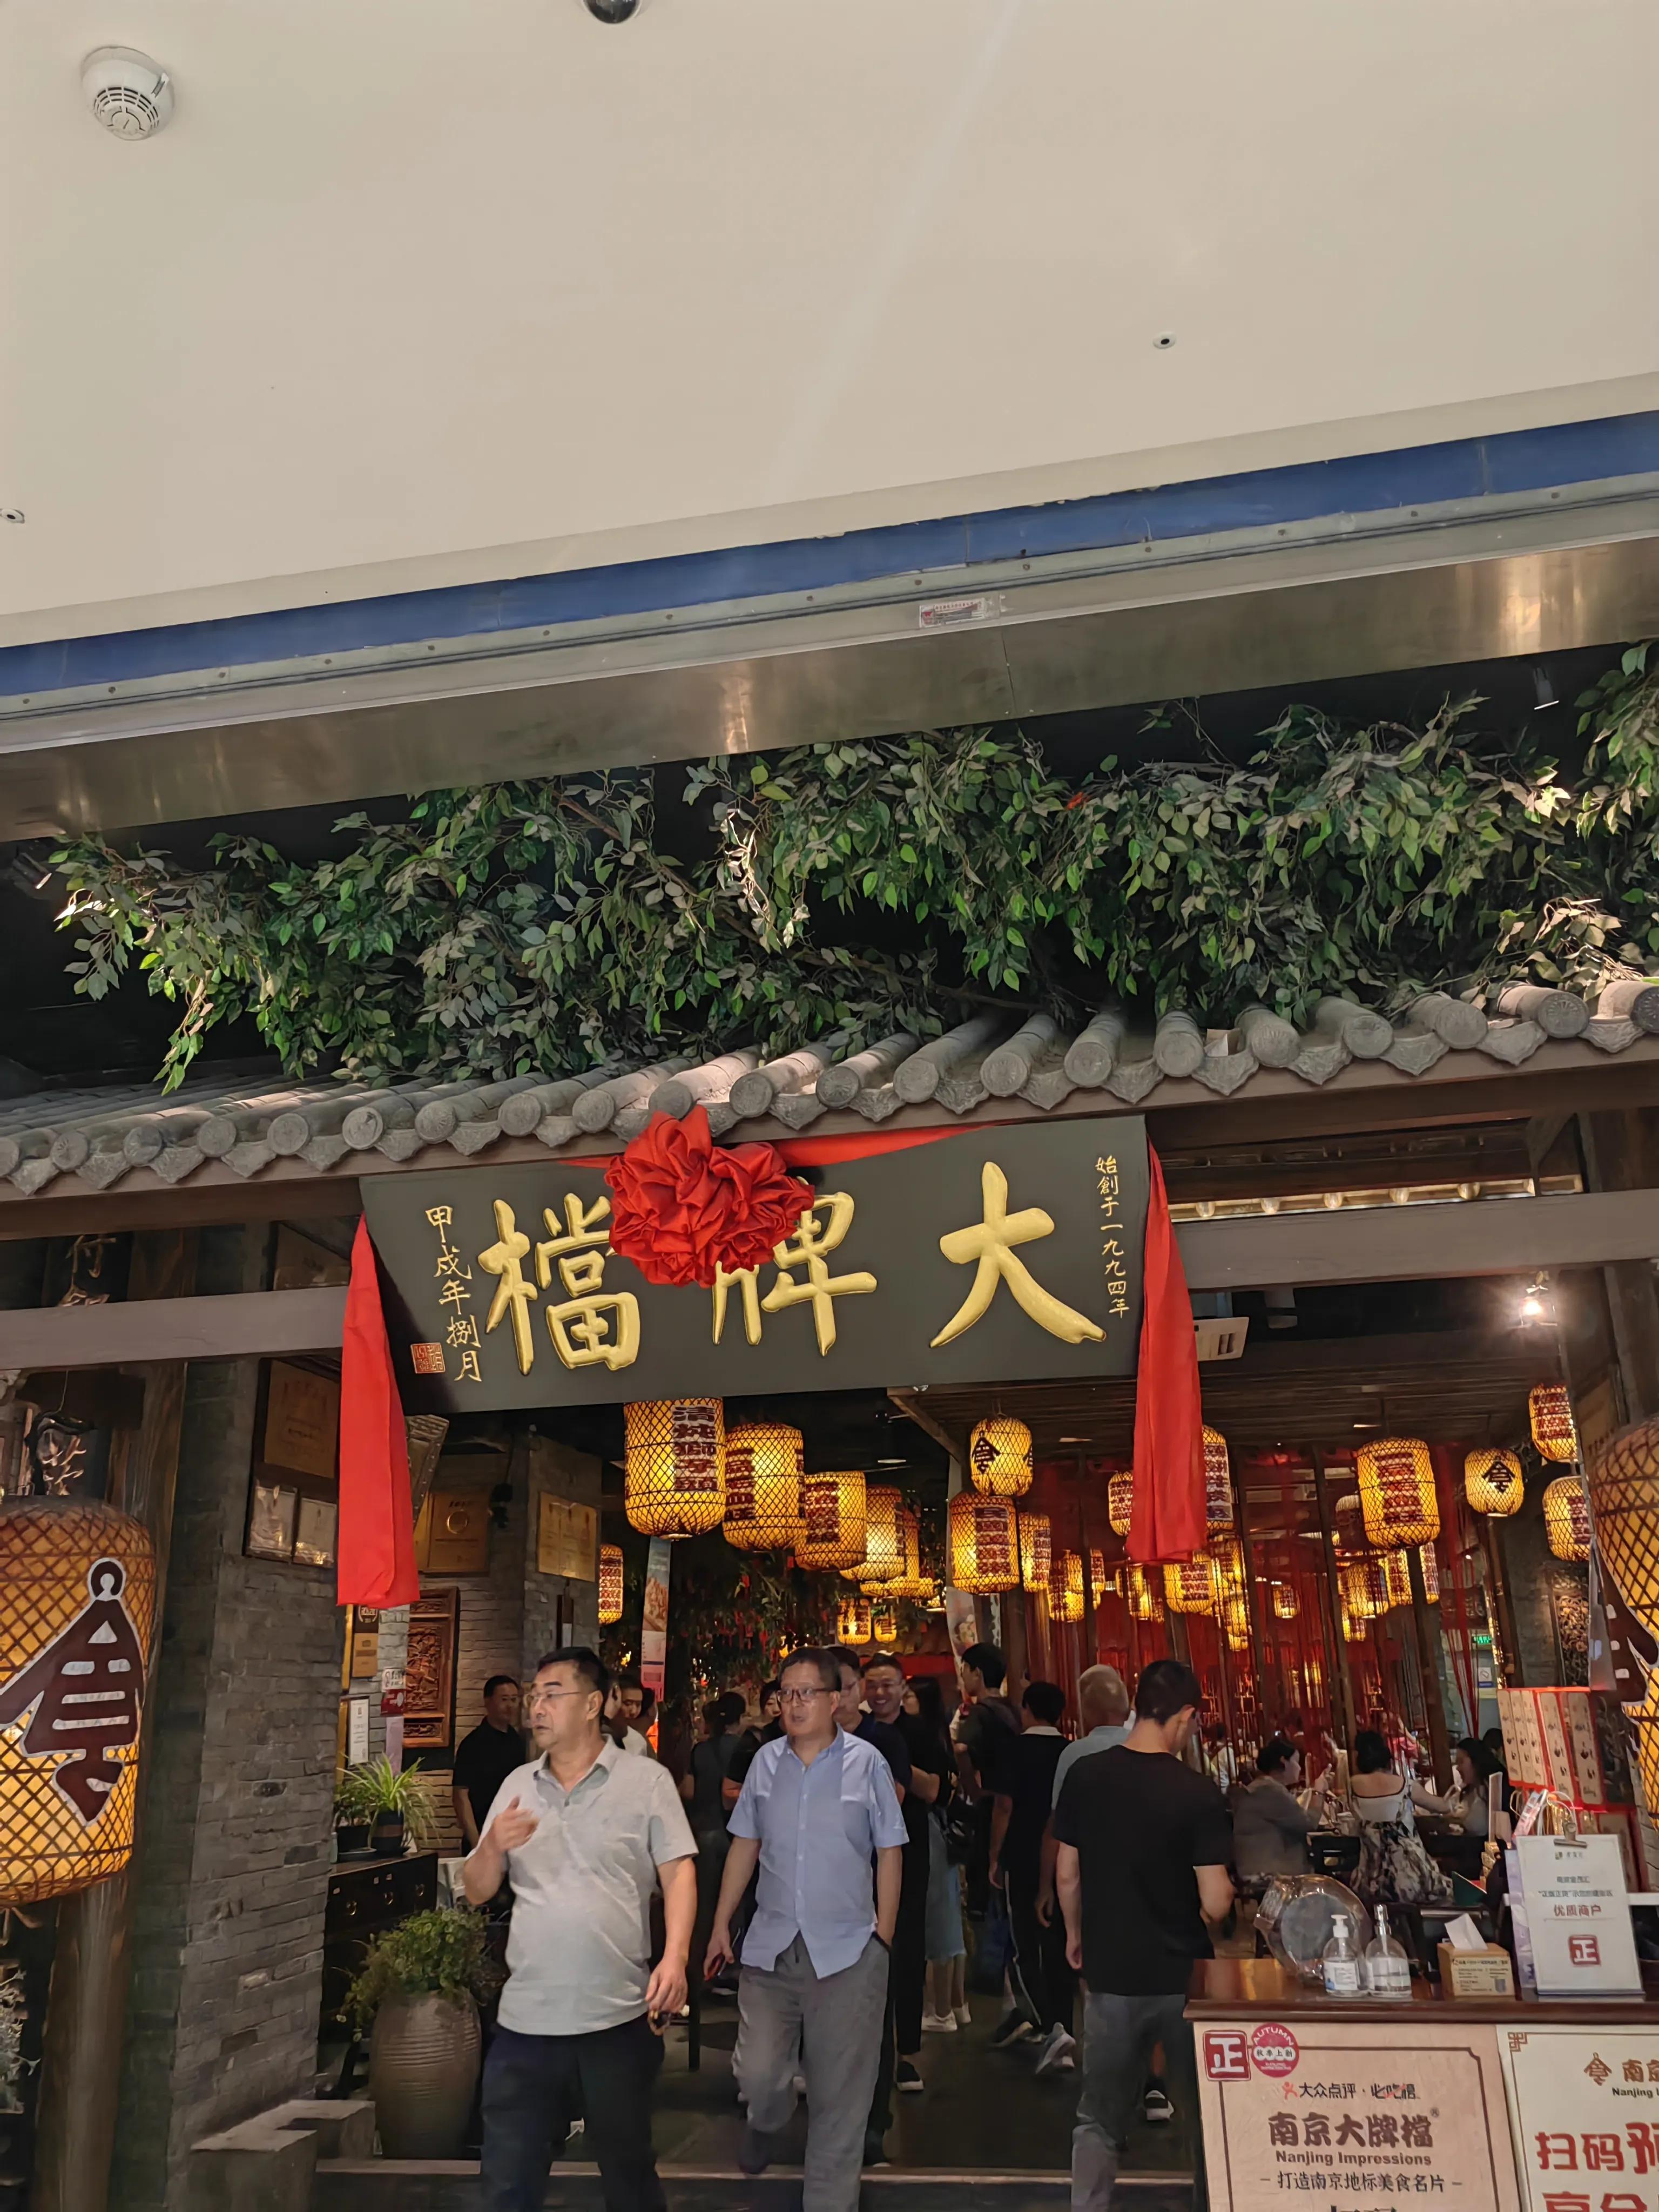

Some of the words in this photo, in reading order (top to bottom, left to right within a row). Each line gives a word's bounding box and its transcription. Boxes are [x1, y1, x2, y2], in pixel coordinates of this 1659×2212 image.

[1095, 1156, 1130, 1318] 始創于一九九四年
[1554, 1904, 1602, 1917] 优质商户
[1253, 2026, 1294, 2046] AUTUMN
[1209, 2037, 1245, 2074] 正
[1611, 2087, 1654, 2099] Nanjing
[1276, 2150, 1333, 2166] Nanjing
[1338, 2152, 1432, 2167] Impressions
[1277, 2170, 1445, 2193] 打造南京地标美食名片
